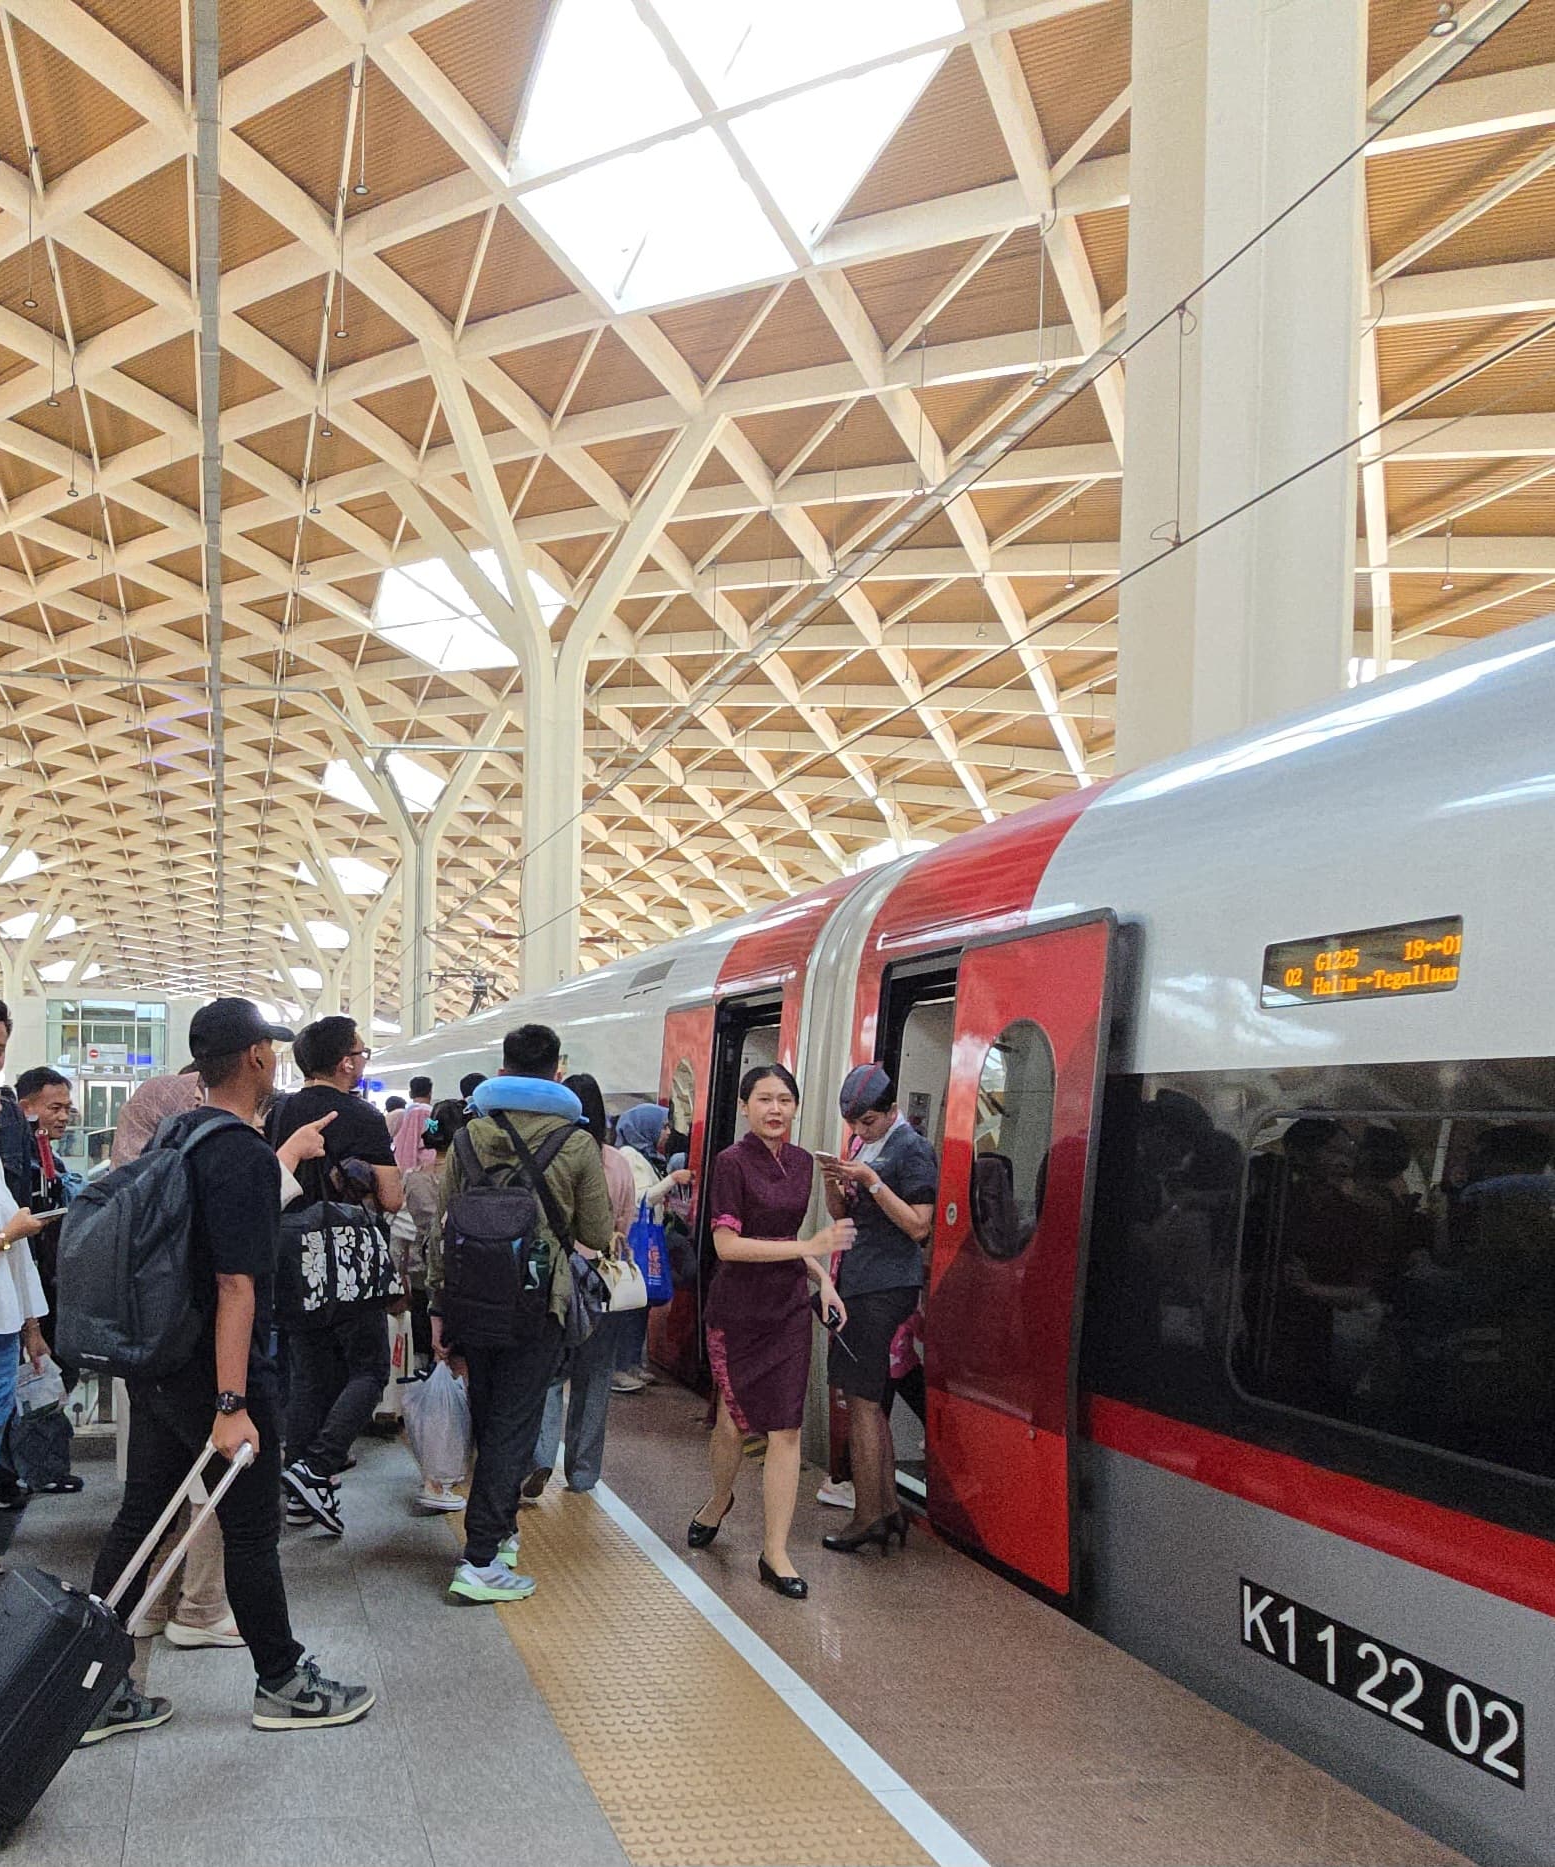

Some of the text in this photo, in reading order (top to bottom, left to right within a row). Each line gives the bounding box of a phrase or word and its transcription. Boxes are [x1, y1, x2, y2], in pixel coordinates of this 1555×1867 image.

[1314, 948, 1359, 972] G1225
[1403, 939, 1425, 960] 18
[1284, 967, 1303, 987] 02
[1312, 974, 1357, 995] Halim
[1244, 1585, 1519, 1779] K1 1 22 02
